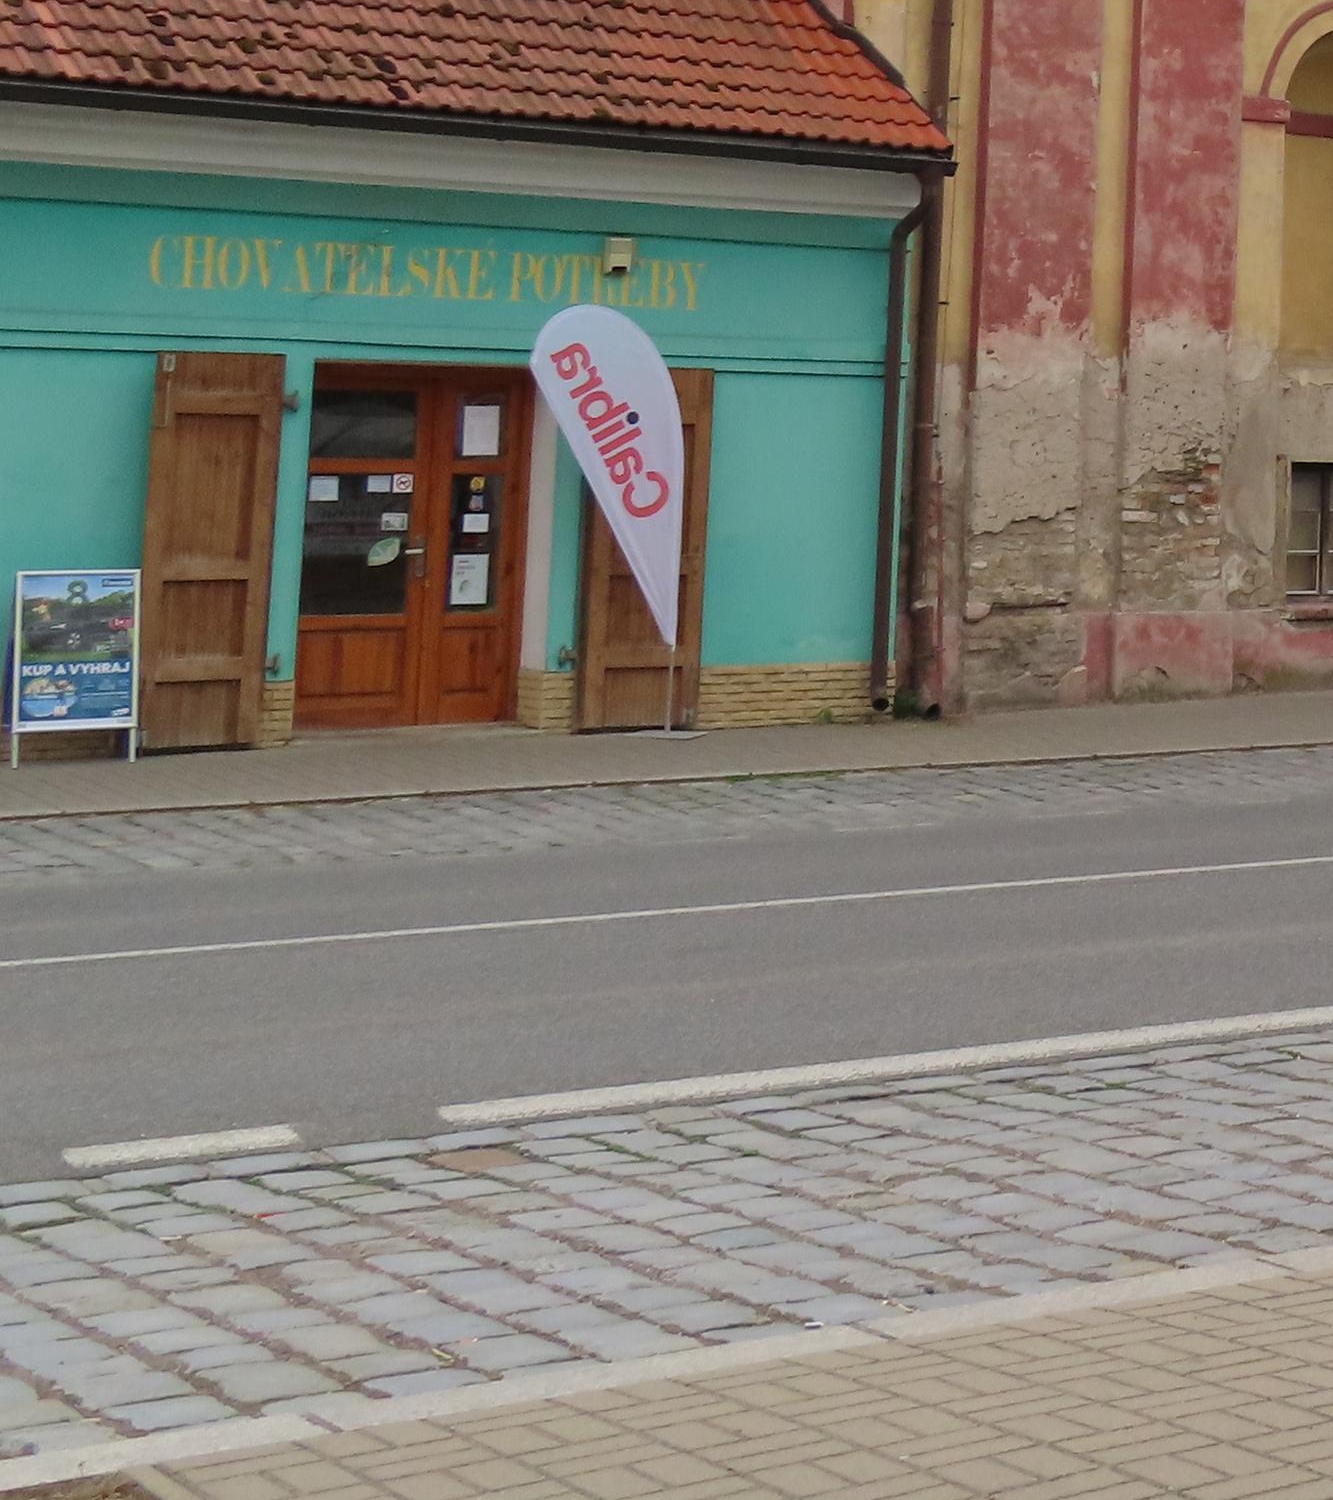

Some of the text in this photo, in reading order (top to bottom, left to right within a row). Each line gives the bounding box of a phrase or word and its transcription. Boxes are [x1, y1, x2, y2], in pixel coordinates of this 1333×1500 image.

[150, 234, 497, 299] CHOVATELSKÉ
[22, 661, 131, 677] KUP A VYHRAJ
